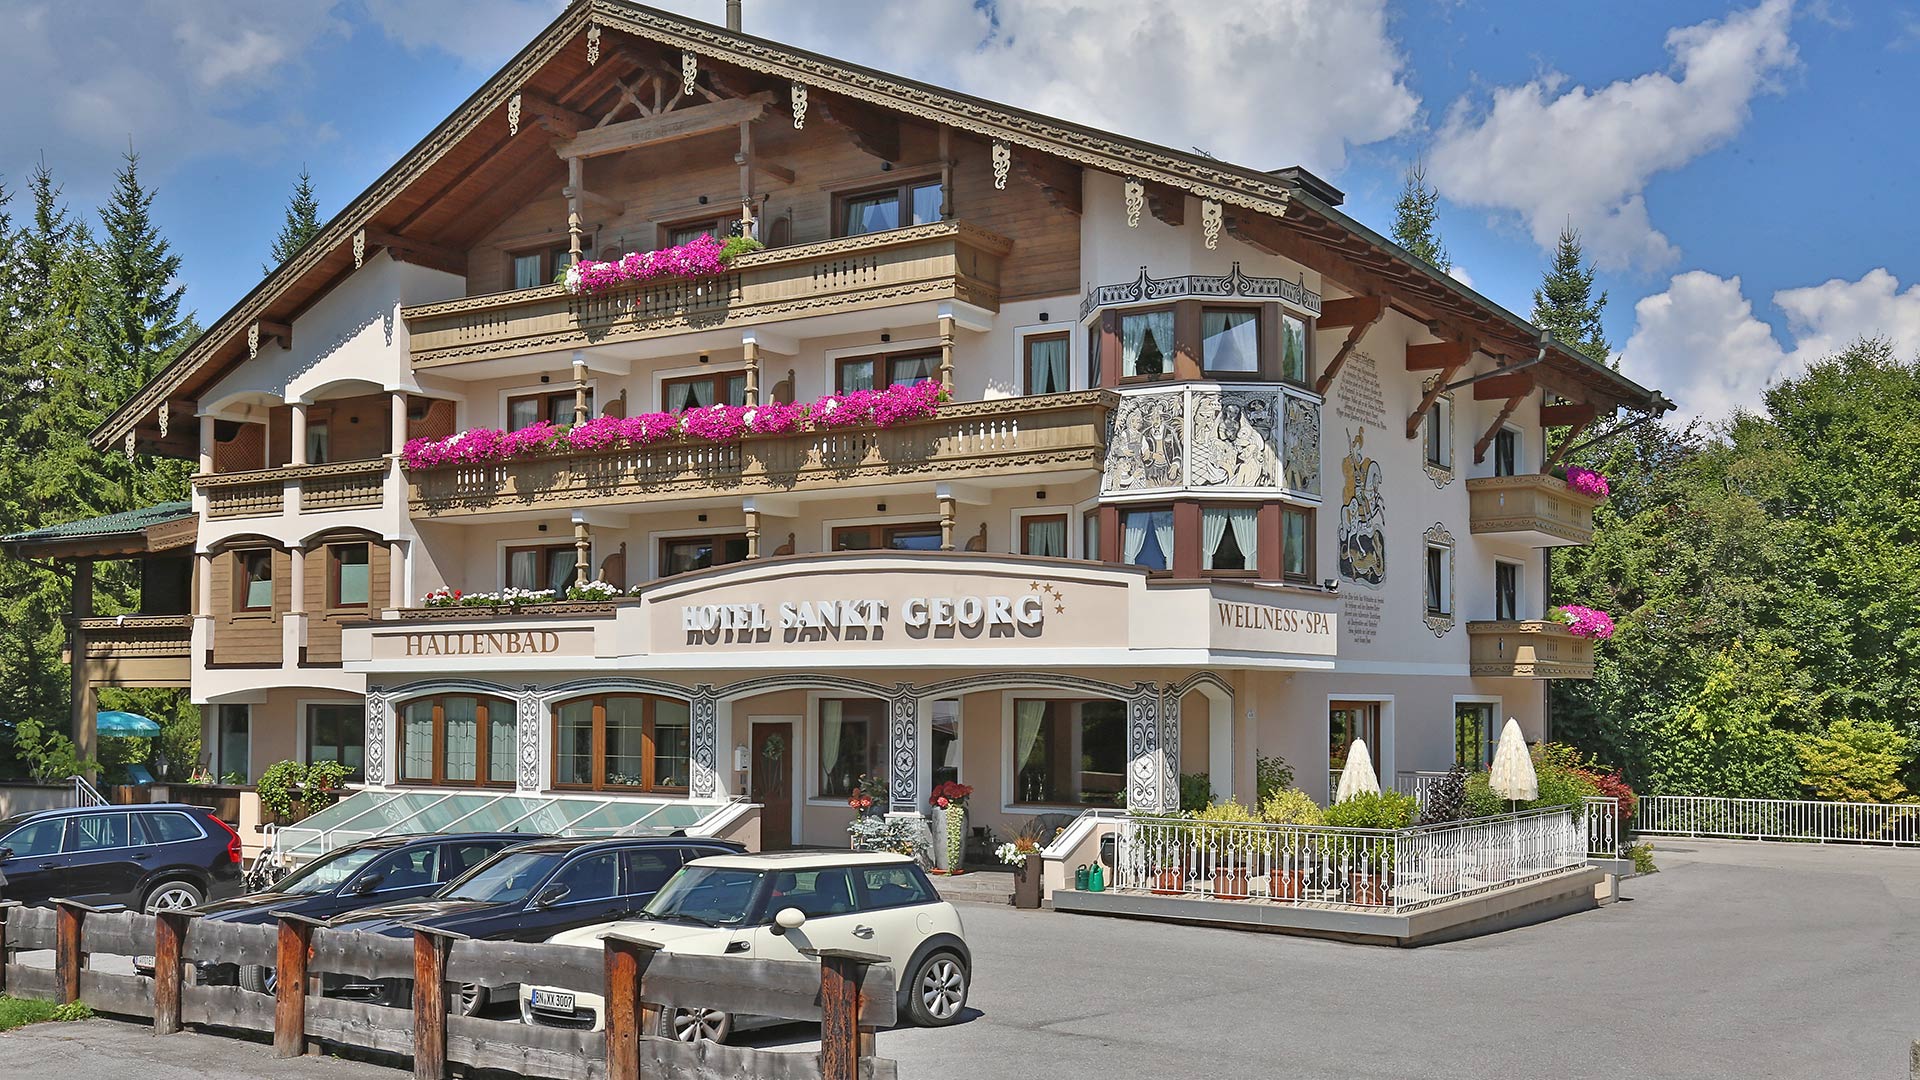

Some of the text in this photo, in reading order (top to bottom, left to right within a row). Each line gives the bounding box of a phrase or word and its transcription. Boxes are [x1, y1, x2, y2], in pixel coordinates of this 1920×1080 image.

[681, 594, 1043, 631] HOTEL SANKT GEORG
[403, 631, 560, 656] HALLENBAD
